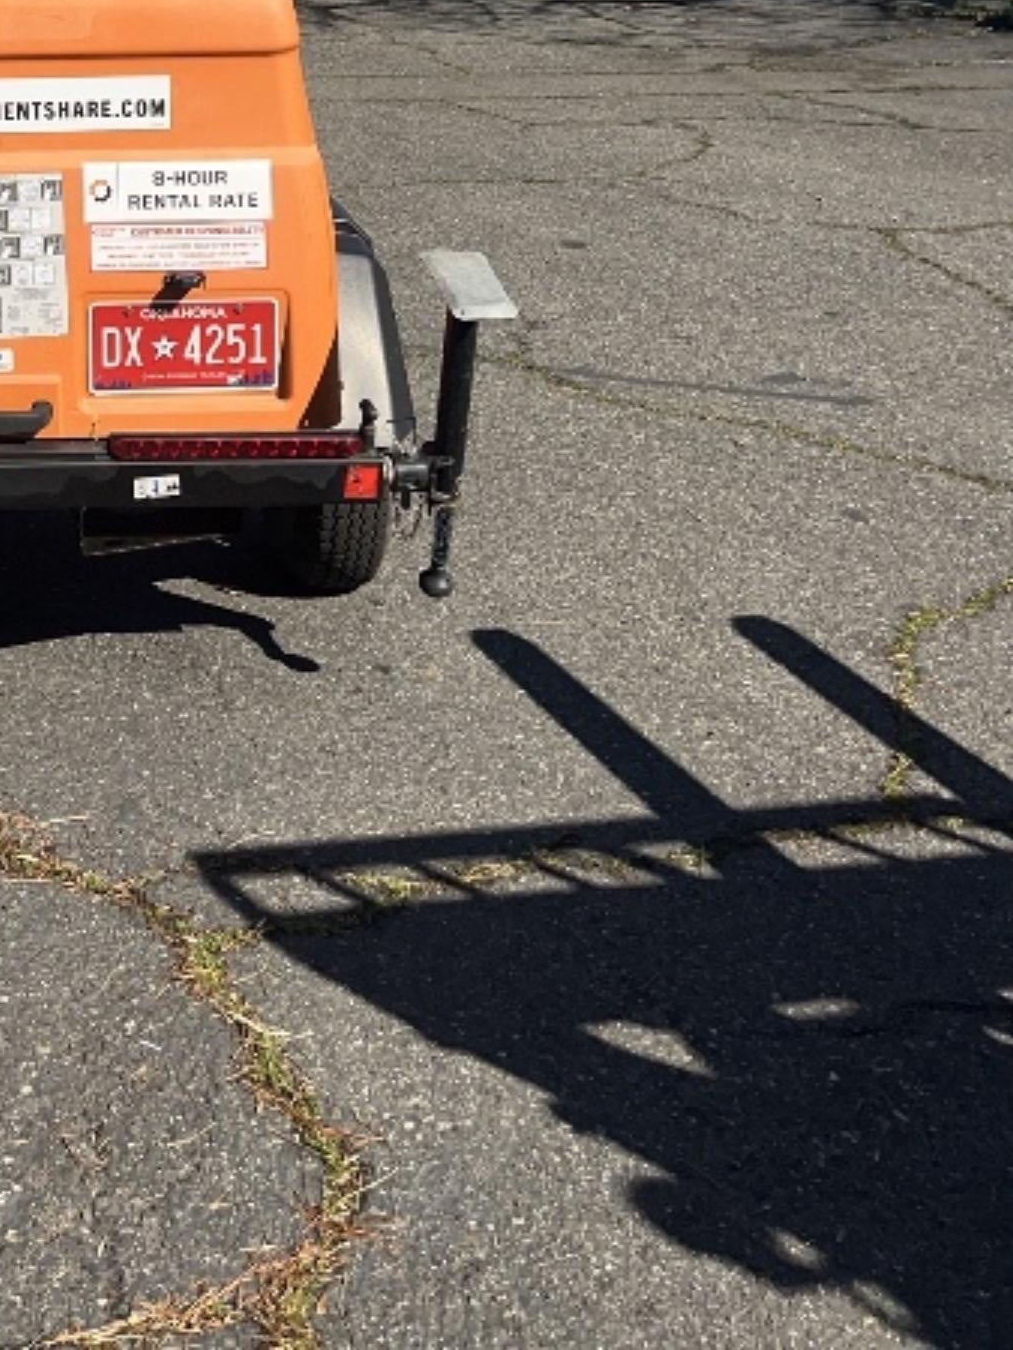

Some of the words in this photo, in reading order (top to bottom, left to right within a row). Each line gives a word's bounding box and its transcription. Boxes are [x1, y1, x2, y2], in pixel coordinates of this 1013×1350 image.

[127, 194, 202, 211] RENTAL
[208, 191, 259, 209] RATE
[101, 325, 145, 369] DX
[183, 322, 268, 366] 4251
